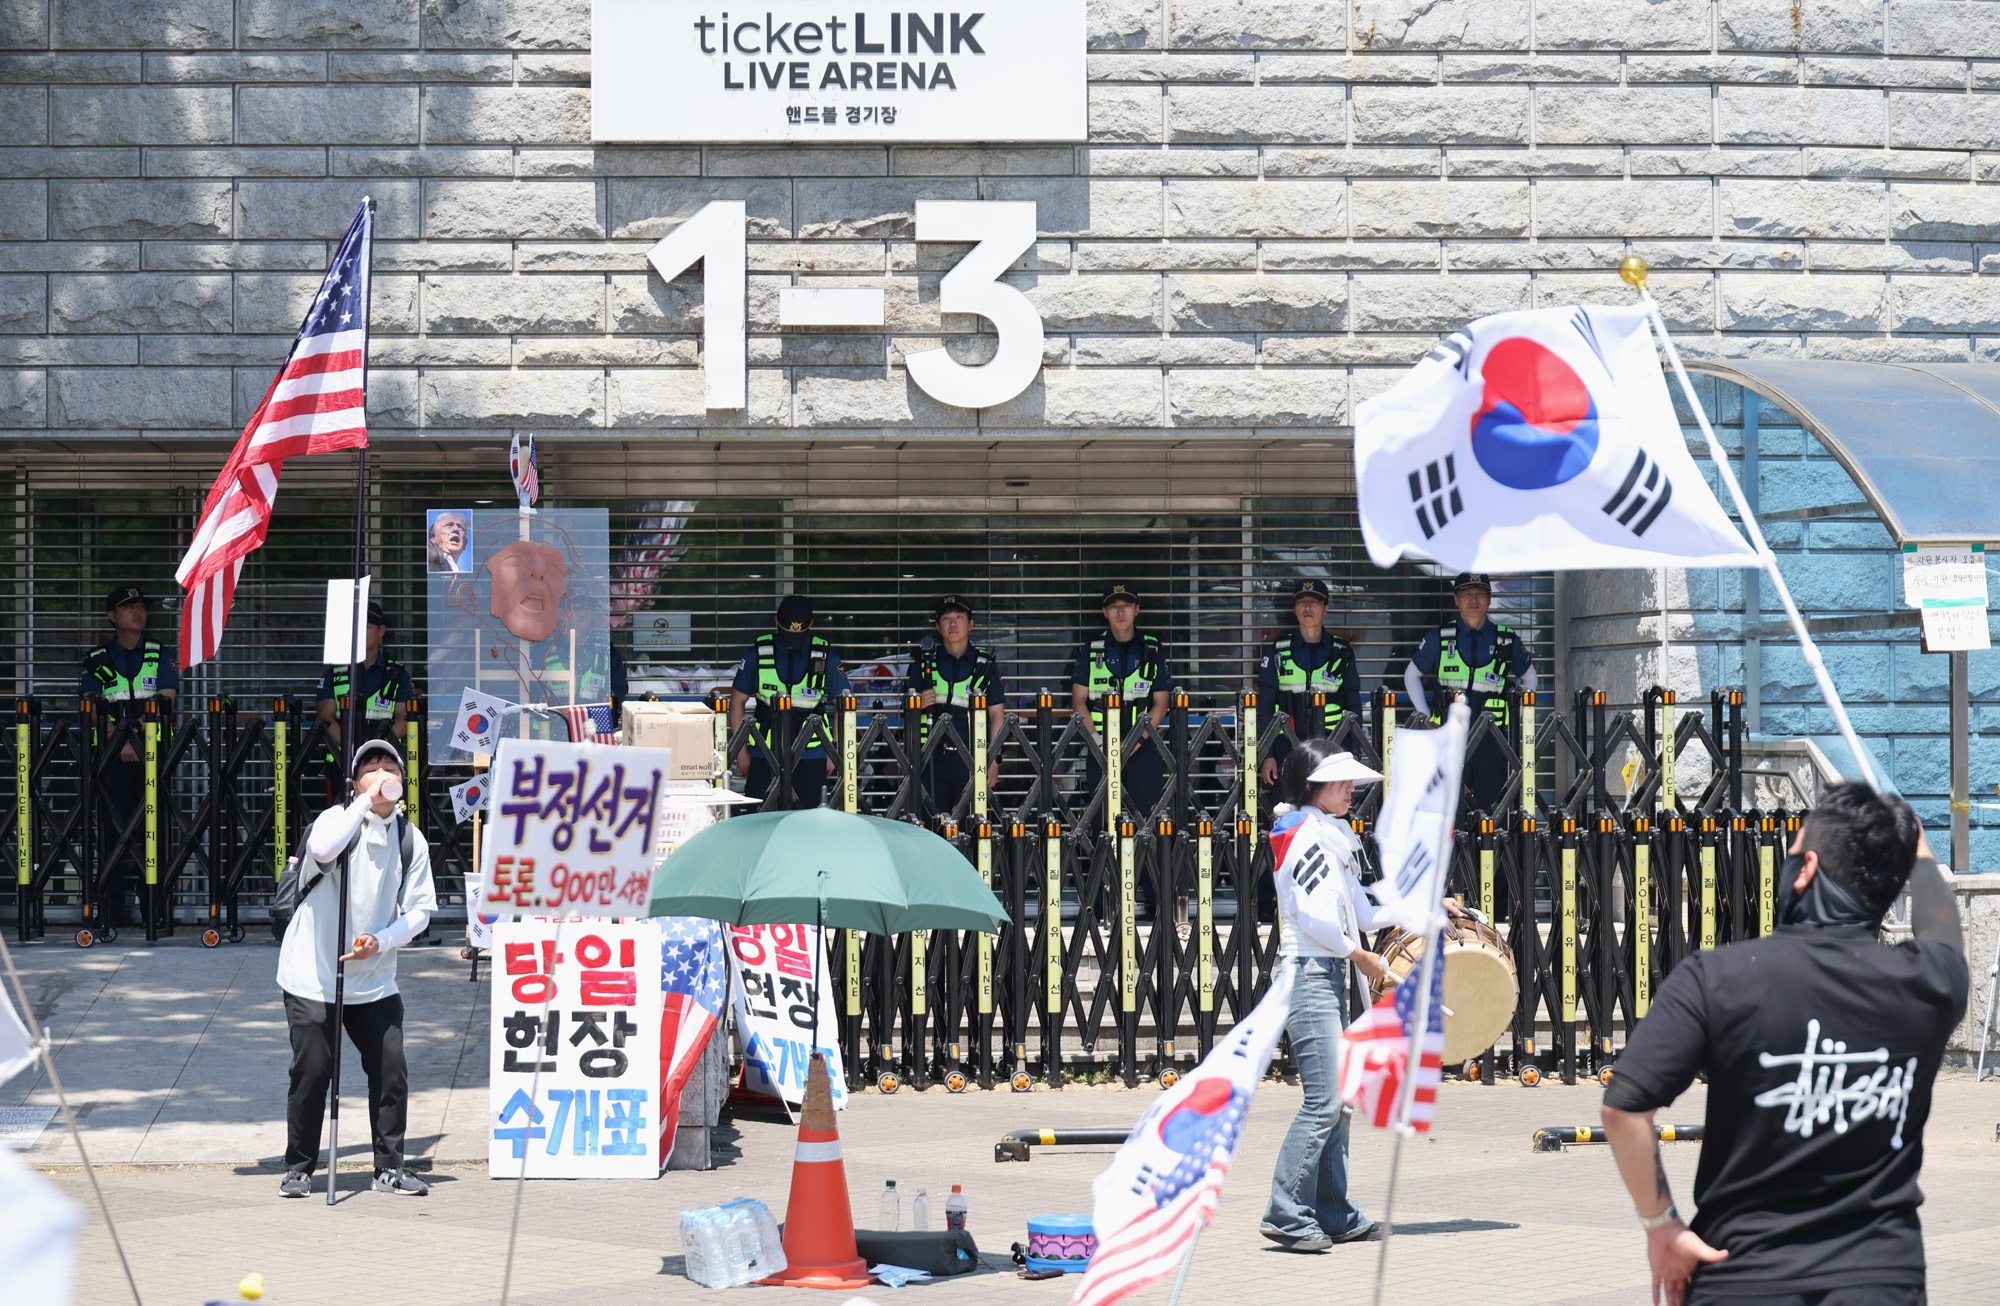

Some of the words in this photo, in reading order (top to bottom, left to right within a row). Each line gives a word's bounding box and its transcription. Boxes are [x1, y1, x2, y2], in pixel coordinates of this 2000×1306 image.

[694, 12, 986, 54] ticketLINK
[724, 61, 810, 90] LIVE
[819, 61, 957, 90] ARENA
[786, 105, 838, 124] 핸드볼
[845, 105, 897, 124] 경기장
[646, 200, 1045, 409] 1-3
[18, 753, 27, 815] POLICE
[275, 751, 283, 813] POLICE
[408, 751, 418, 814] 질서유
[847, 740, 855, 803] POLICE
[977, 739, 986, 802] 질서유
[1110, 738, 1119, 800] POLICE
[1525, 735, 1535, 798] 질서유
[1666, 734, 1674, 796] POLICE
[145, 752, 155, 868] 질서유지선
[501, 755, 662, 855] 부정선거
[546, 862, 616, 907] 900만
[1124, 869, 1133, 936] POLICE
[1483, 882, 1492, 914] POL
[1638, 877, 1647, 943] POLICE
[1704, 878, 1715, 946] 질서유
[1763, 877, 1773, 933] POLIC
[1050, 870, 1060, 995] 질서유지선
[1201, 868, 1212, 994] 질서유지선
[1564, 880, 1575, 1005] 질서유지선
[505, 934, 637, 1006] 당일
[914, 930, 925, 996] 유지선
[1639, 956, 1647, 1000] LINE
[741, 968, 821, 1031] 현장
[503, 1010, 638, 1079] 현장
[494, 1087, 648, 1159] 수개표
